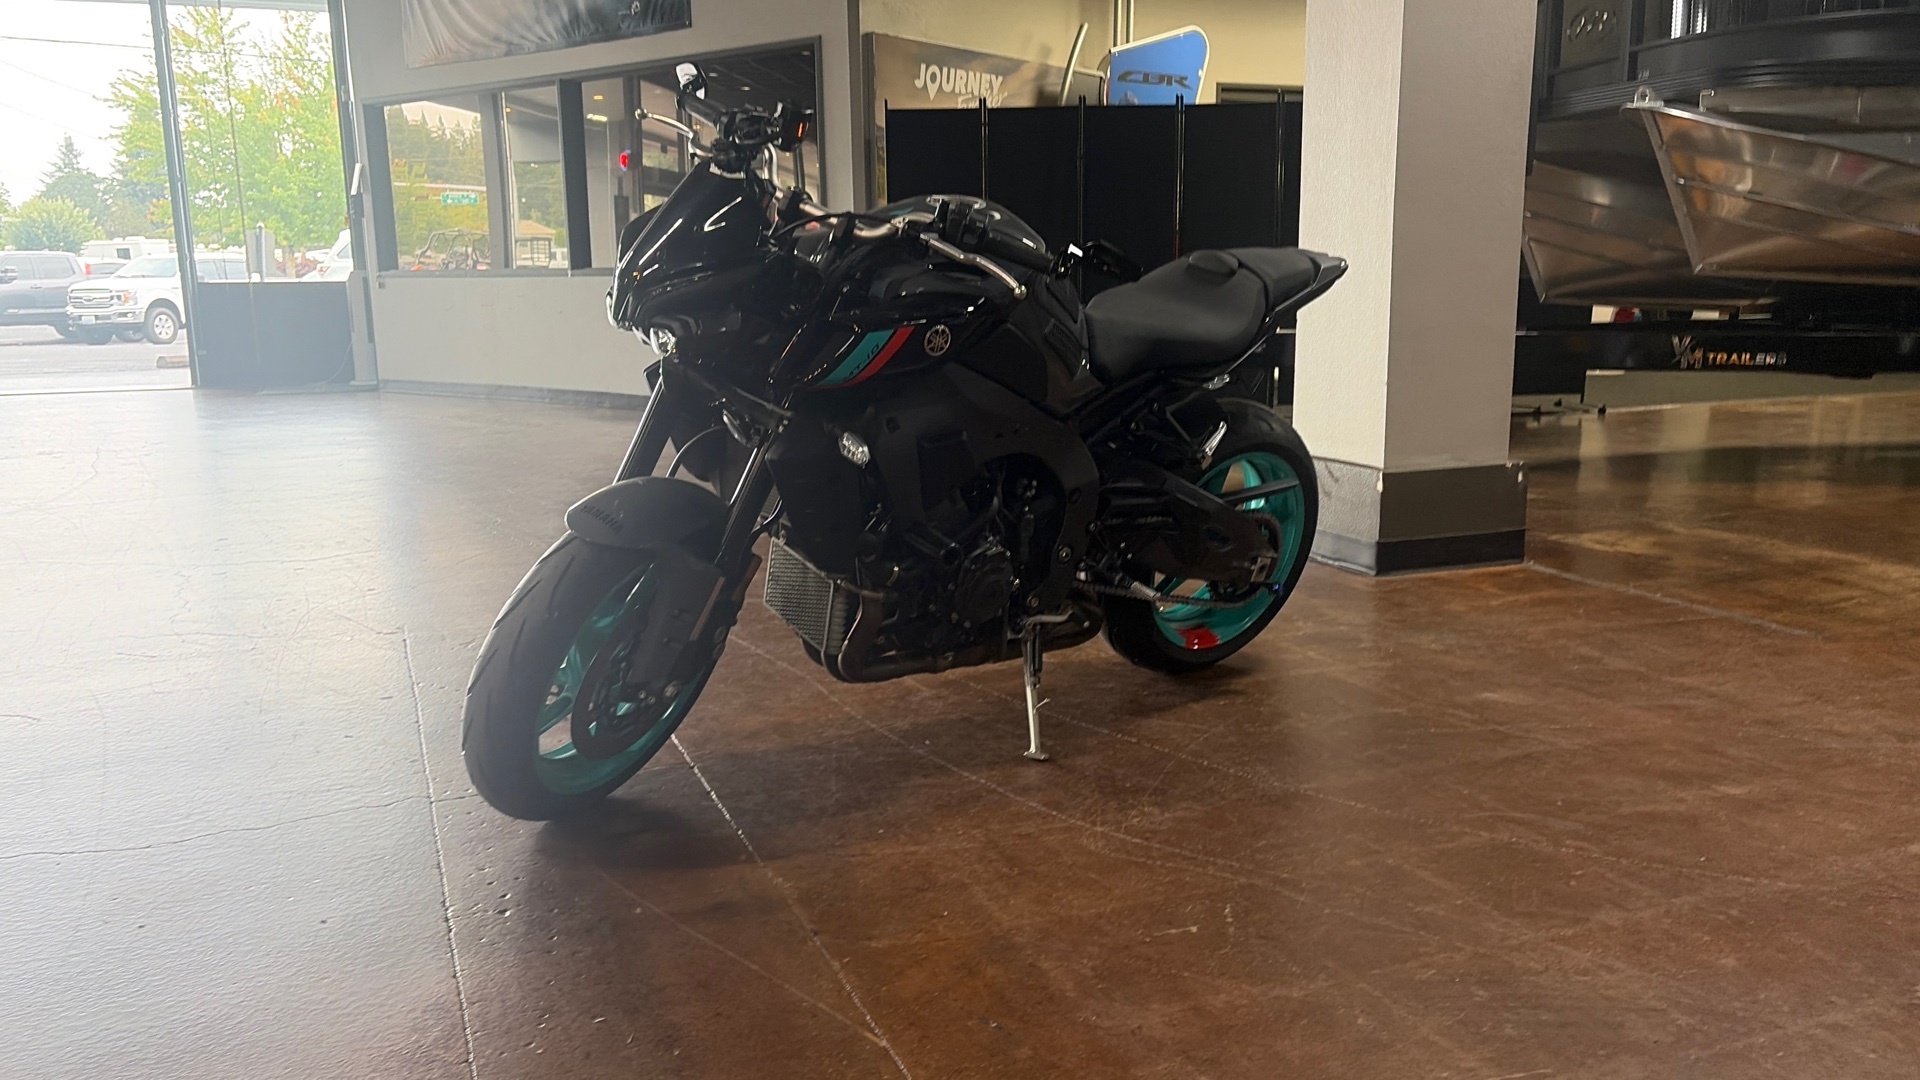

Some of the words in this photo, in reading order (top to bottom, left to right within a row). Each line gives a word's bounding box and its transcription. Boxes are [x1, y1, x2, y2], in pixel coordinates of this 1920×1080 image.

[914, 63, 1003, 101] JOURNEY
[1706, 351, 1788, 366] TRAILERS
[580, 505, 624, 535] YAMAHA
